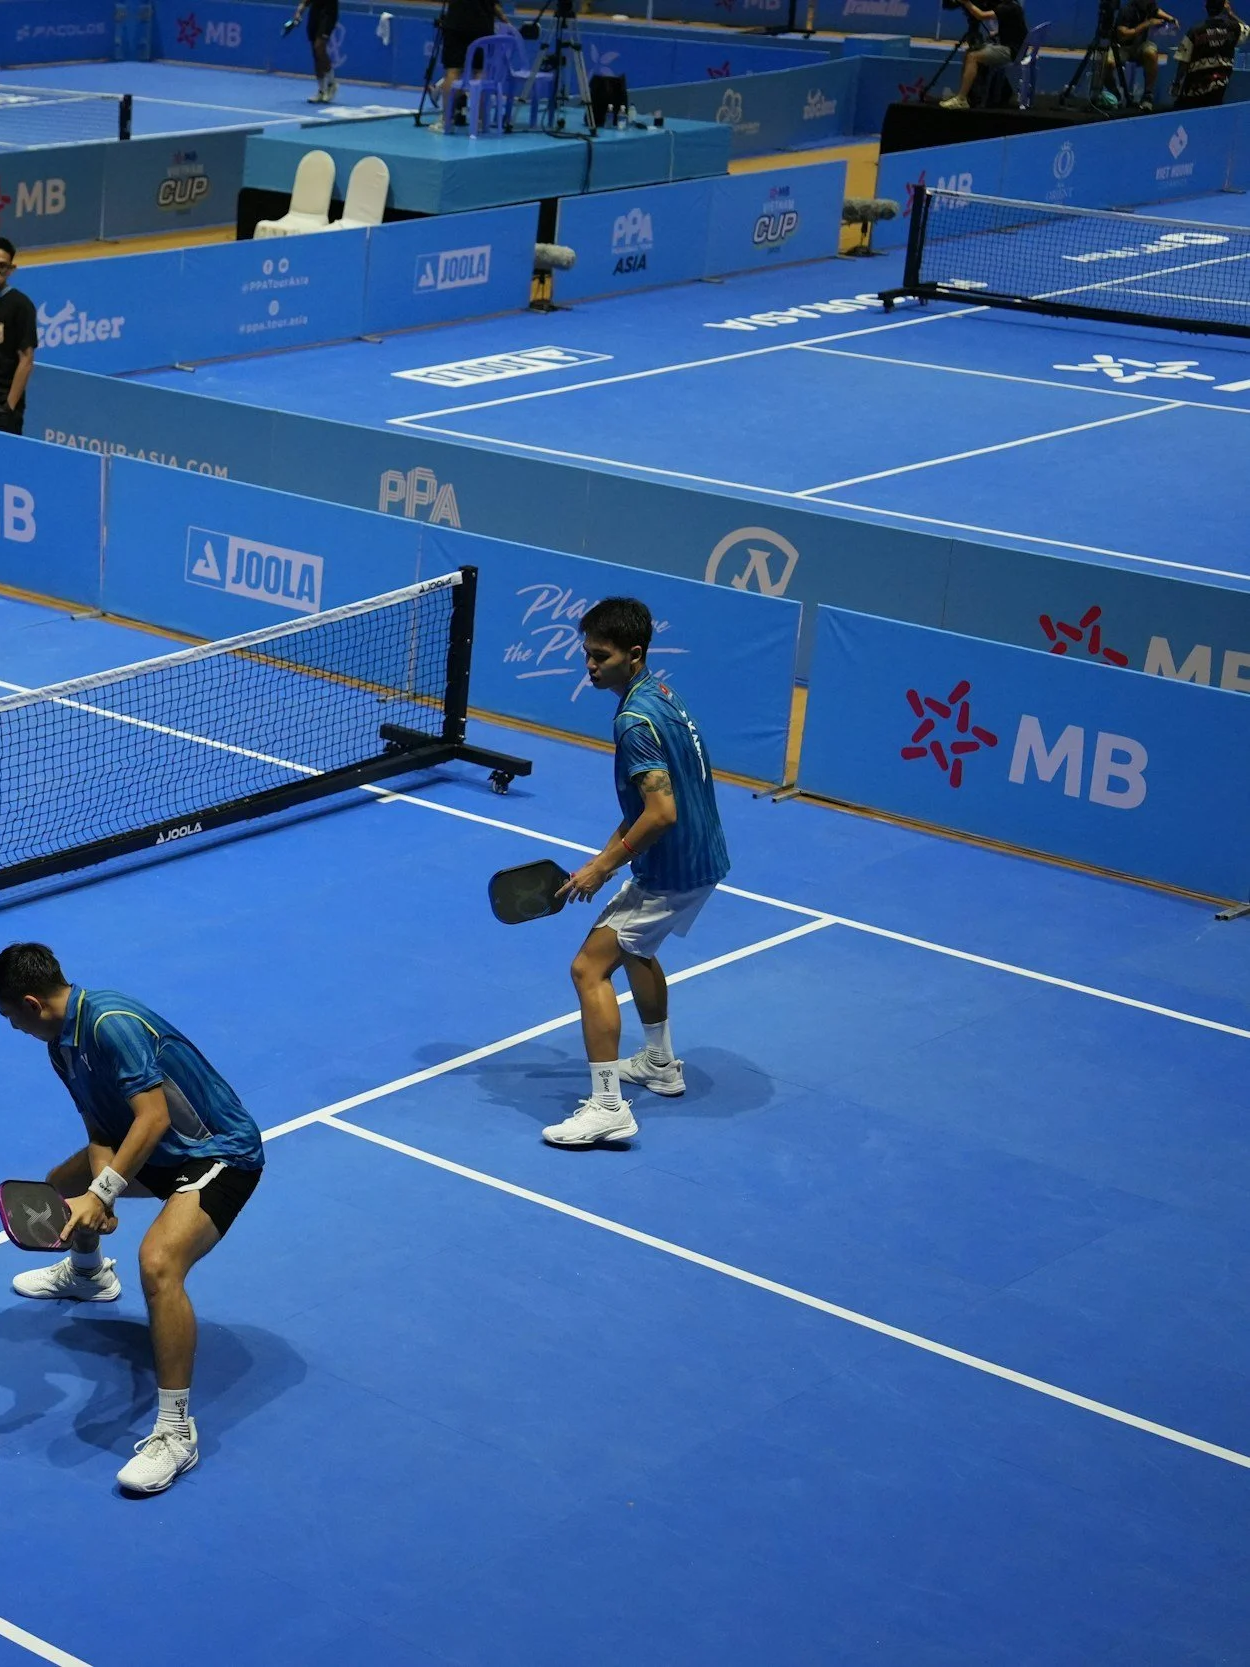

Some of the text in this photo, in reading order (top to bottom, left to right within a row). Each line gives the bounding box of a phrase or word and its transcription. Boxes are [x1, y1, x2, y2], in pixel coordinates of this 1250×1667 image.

[205, 21, 241, 47] MB
[15, 178, 66, 217] MB
[158, 176, 208, 205] CUP
[934, 172, 973, 211] MB
[612, 208, 653, 246] PPA
[752, 210, 798, 244] CUP
[441, 252, 487, 282] JOOLA
[612, 253, 647, 276] ASIA
[378, 466, 461, 529] PPA
[231, 548, 316, 604] JOOLA
[503, 641, 534, 663] the
[1008, 714, 1150, 809] MB
[164, 821, 203, 842] JOOLA
